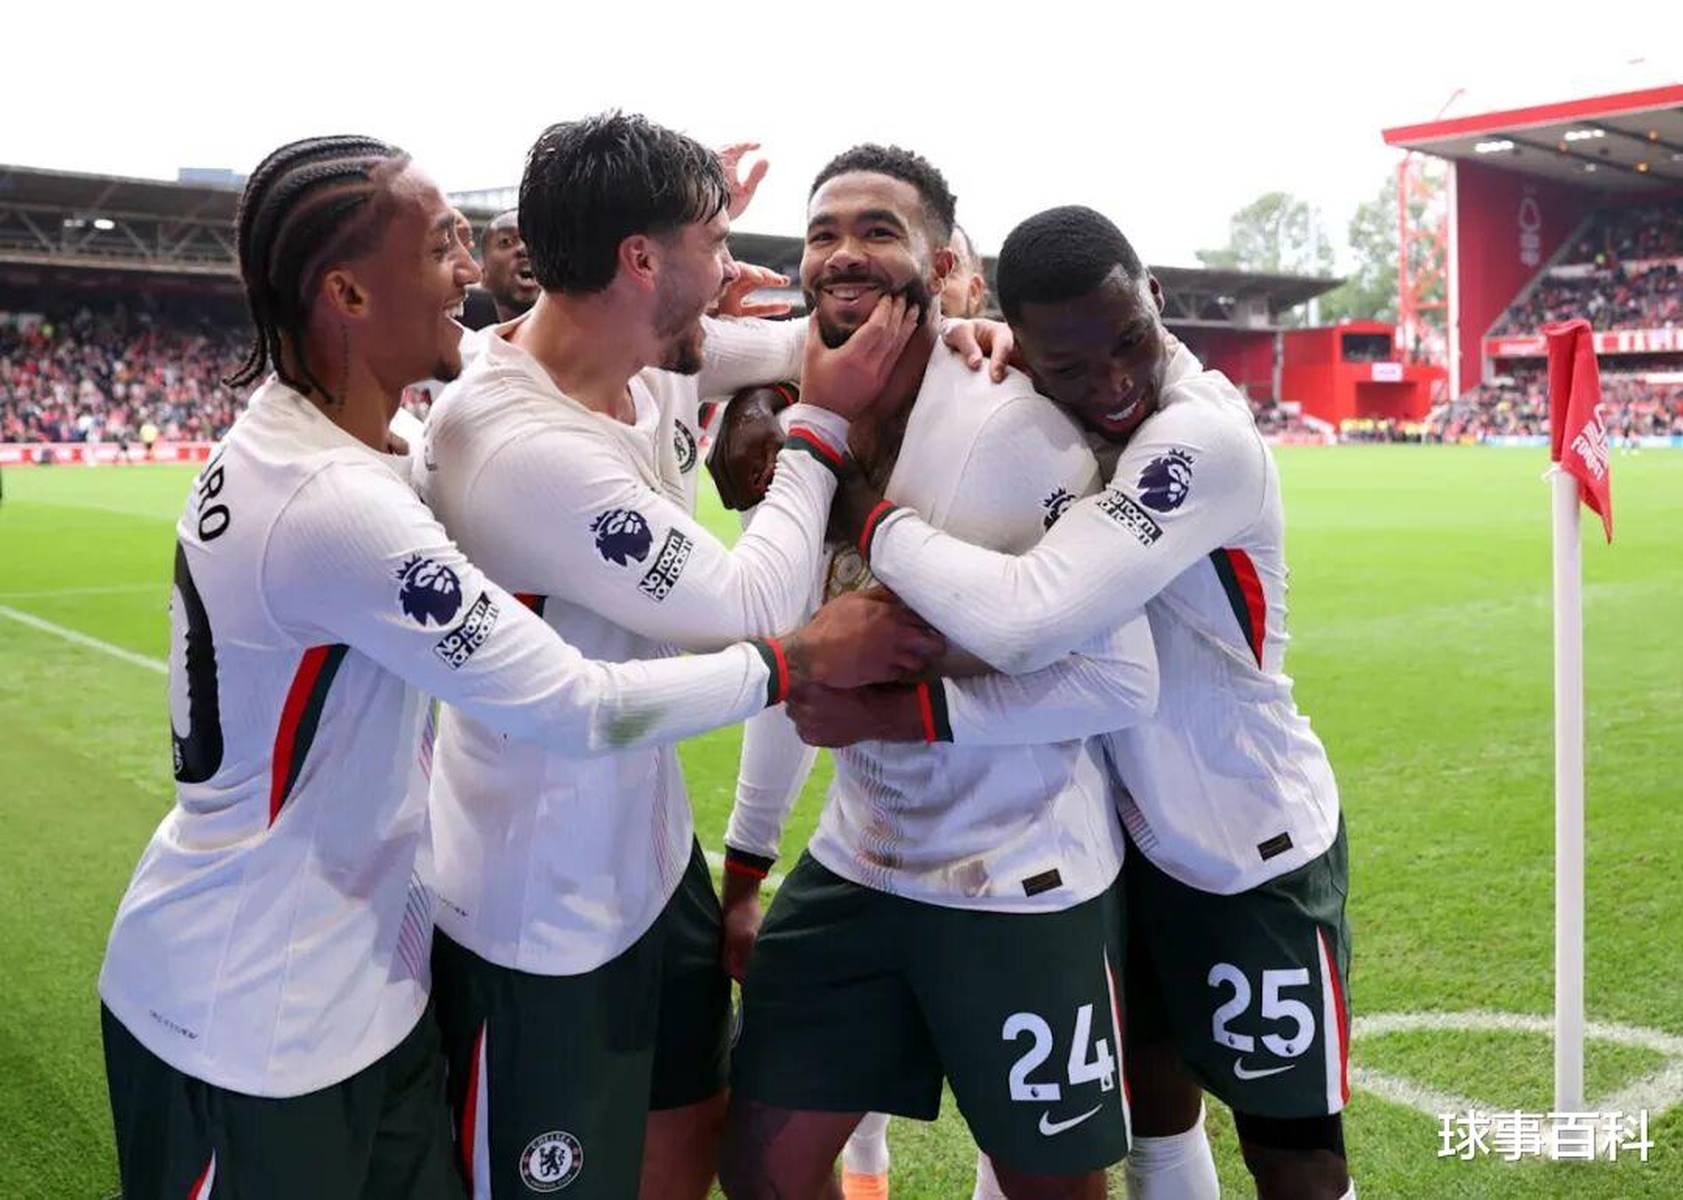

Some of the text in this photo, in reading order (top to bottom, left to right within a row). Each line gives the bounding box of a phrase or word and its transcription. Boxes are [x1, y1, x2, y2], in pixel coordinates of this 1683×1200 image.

[1119, 500, 1156, 535] room
[639, 536, 682, 600] No room
[653, 579, 671, 602] for
[434, 600, 488, 662] No room
[447, 644, 470, 669] for
[1207, 962, 1315, 1058] 25
[1002, 1003, 1115, 1101] 24
